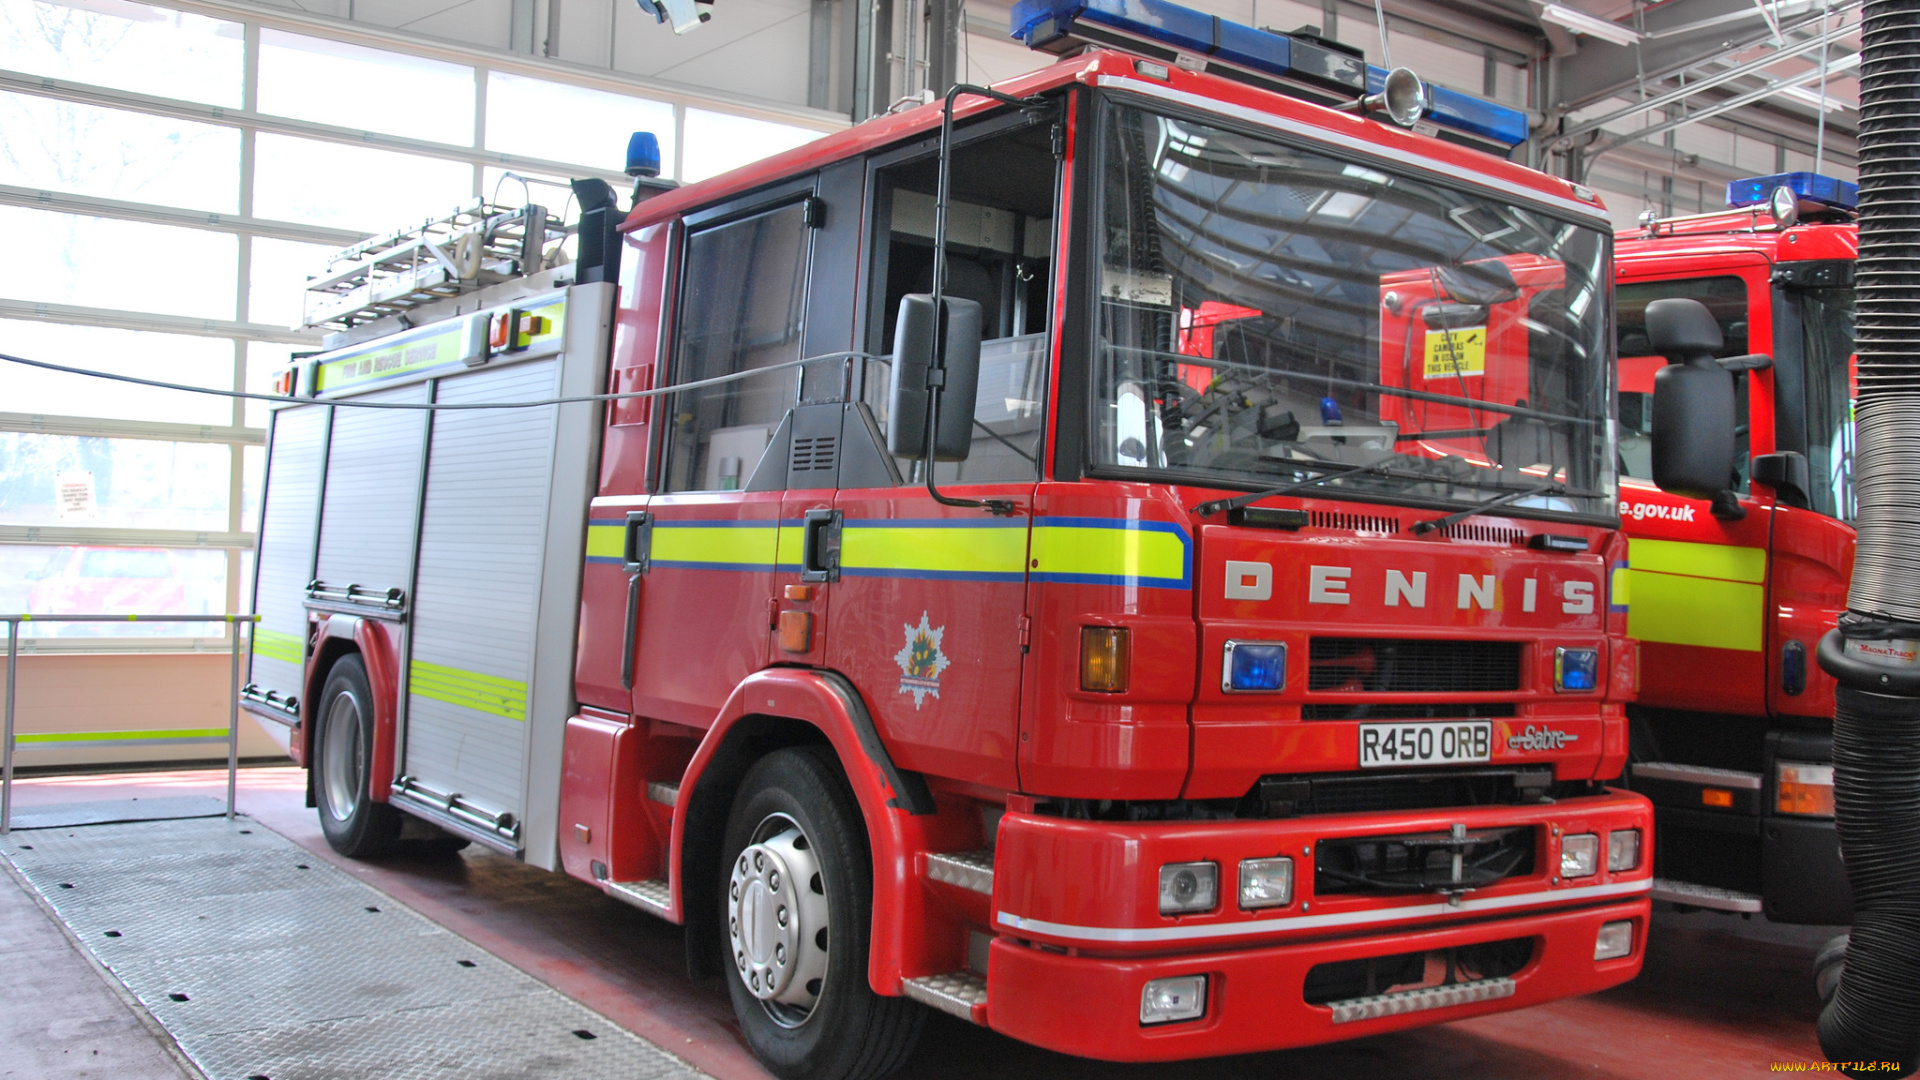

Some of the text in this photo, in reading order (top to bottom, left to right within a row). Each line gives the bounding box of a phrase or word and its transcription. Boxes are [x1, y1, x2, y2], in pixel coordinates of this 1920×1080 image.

[1225, 560, 1594, 615] DENNIS
[1363, 726, 1488, 762] R450 ORB
[1522, 724, 1567, 750] Sabre
